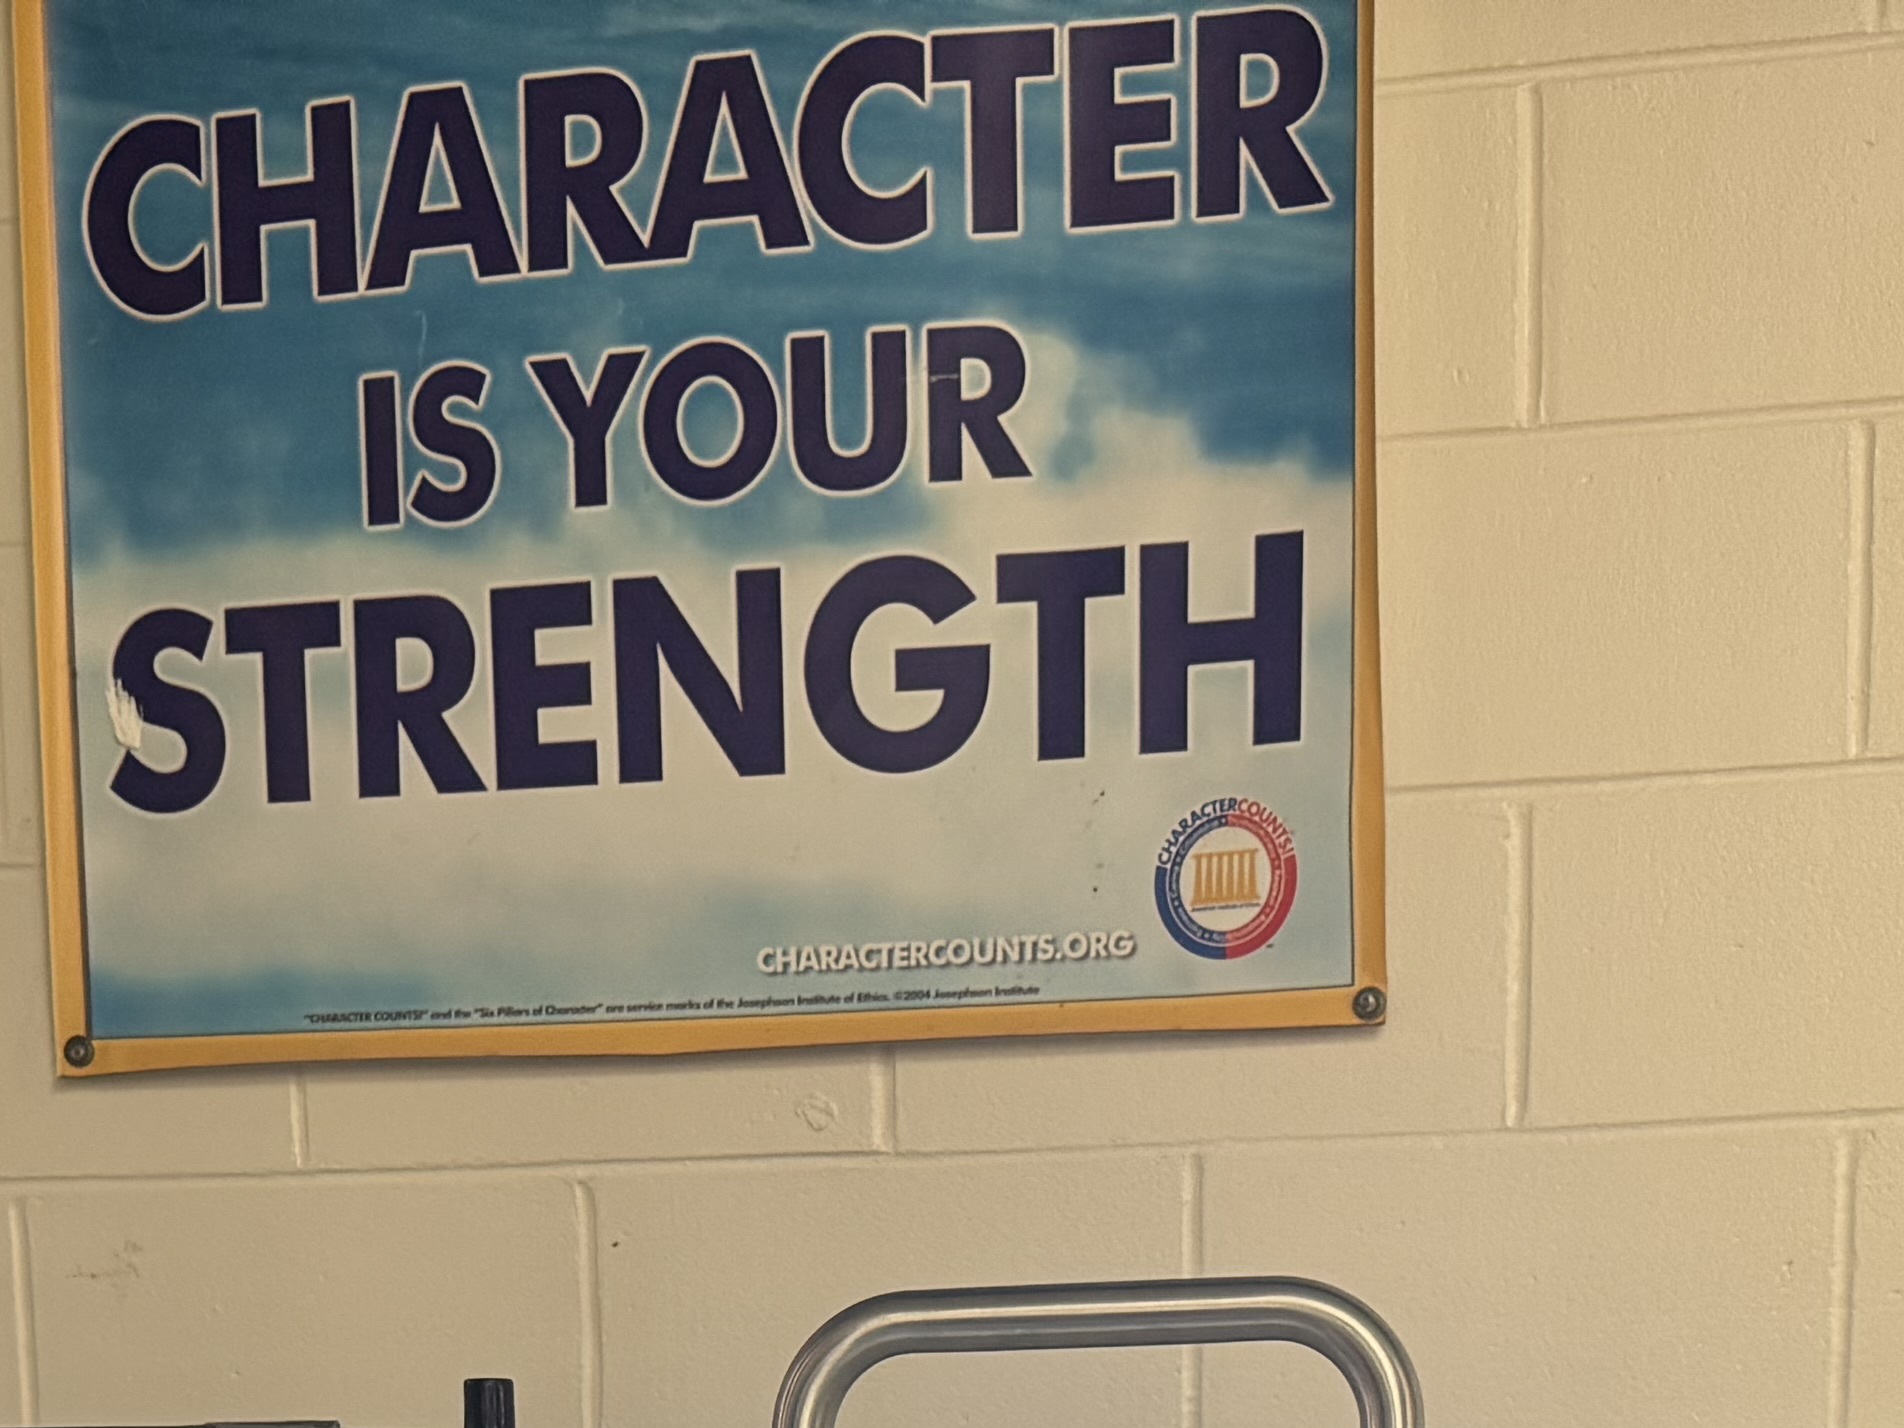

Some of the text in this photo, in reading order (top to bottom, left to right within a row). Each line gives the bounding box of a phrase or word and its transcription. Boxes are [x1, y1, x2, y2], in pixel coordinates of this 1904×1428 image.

[87, 8, 1330, 317] CHARACTER
[359, 325, 1032, 527] IS YOUR
[109, 529, 1305, 813] STRENGTH
[757, 931, 1135, 973] CHARACTERCOUNTS.ORG
